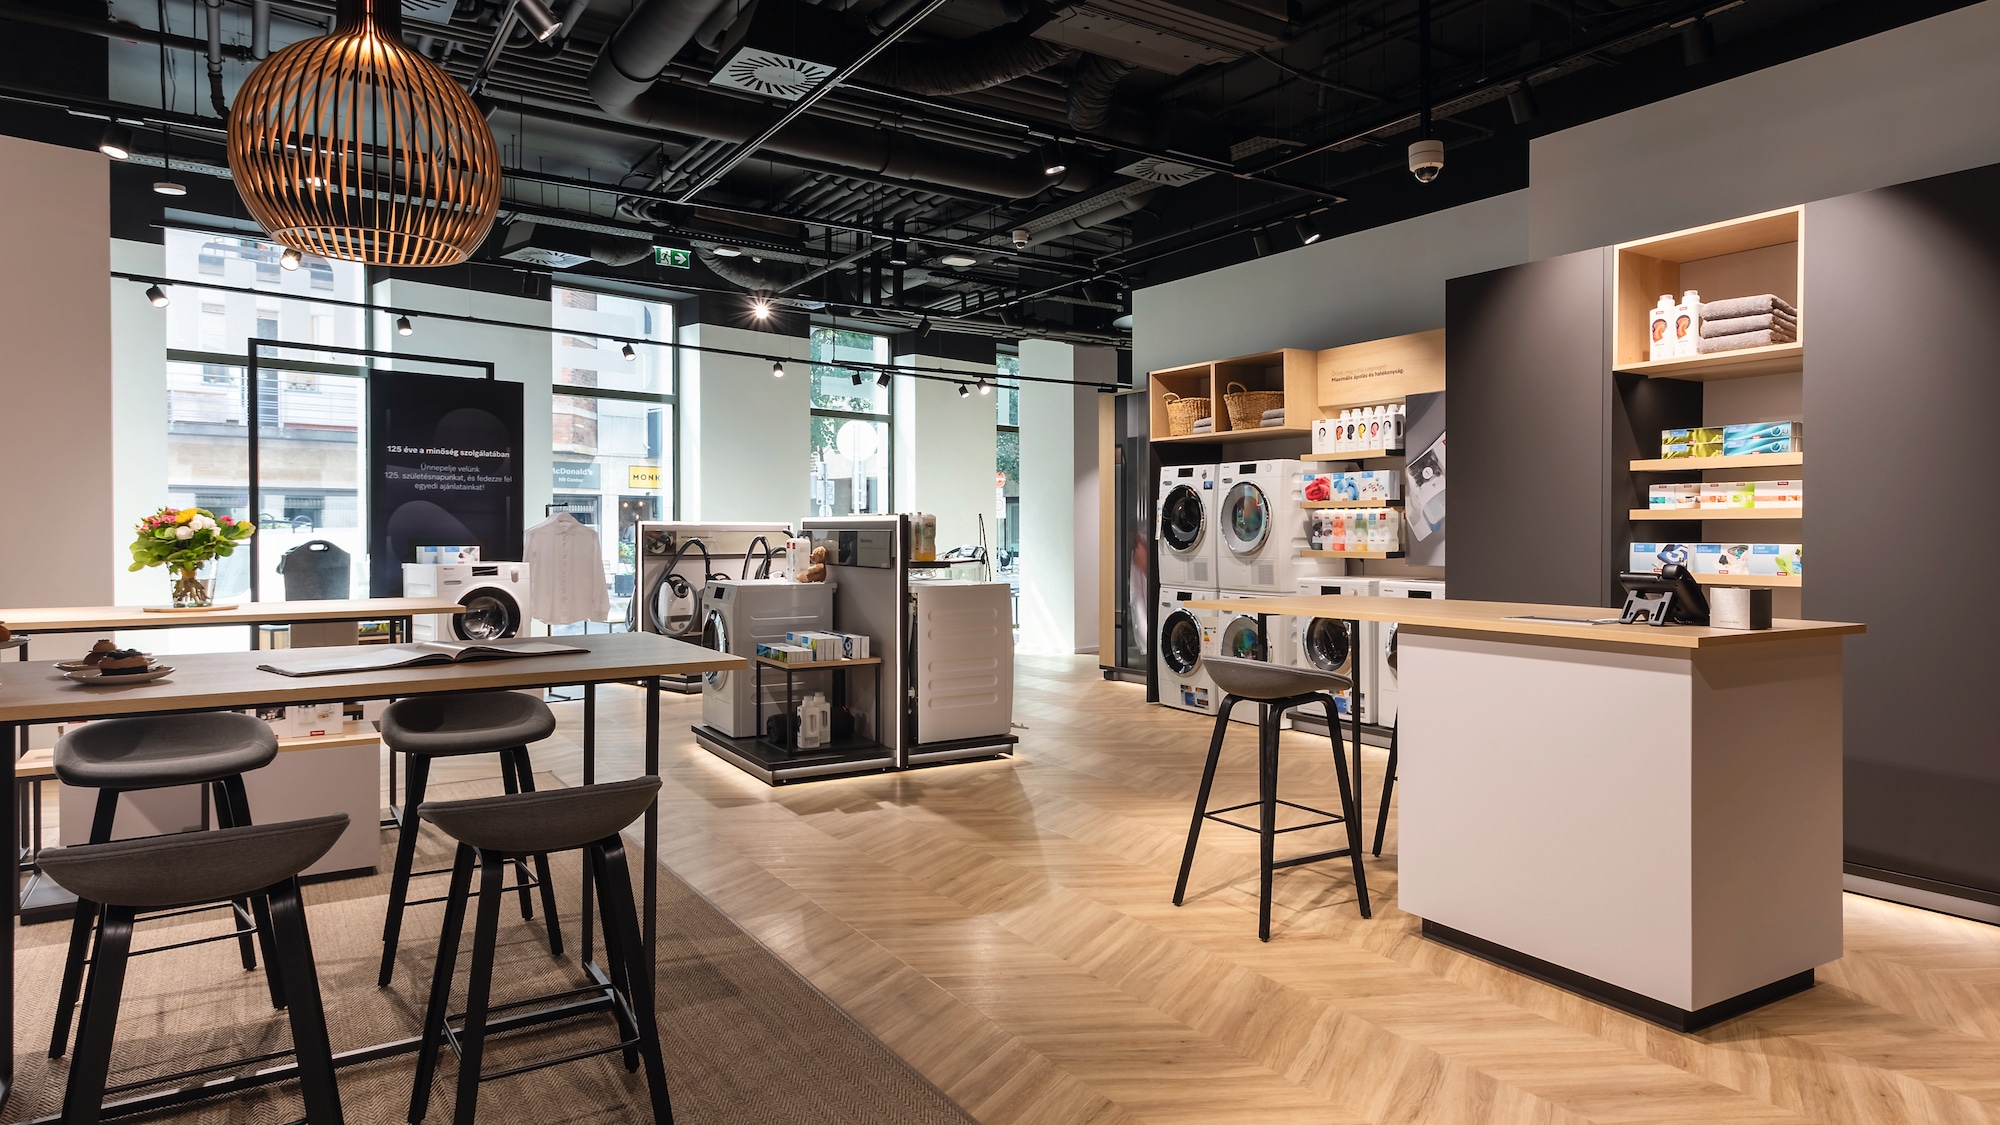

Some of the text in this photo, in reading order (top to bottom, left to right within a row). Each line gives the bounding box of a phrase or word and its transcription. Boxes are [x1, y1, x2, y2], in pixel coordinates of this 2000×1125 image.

[1375, 368, 1404, 376] hatékonyság.
[387, 445, 402, 453] 125
[403, 446, 418, 454] éve
[426, 447, 459, 457] minőség
[460, 448, 510, 458] szolgálatában
[420, 463, 480, 473] Ünnepelje velünk
[402, 472, 466, 483] születésnapunkat,
[467, 474, 476, 482] és
[503, 475, 512, 483] fel
[415, 482, 485, 492] egyedi ajánlatainkat!
